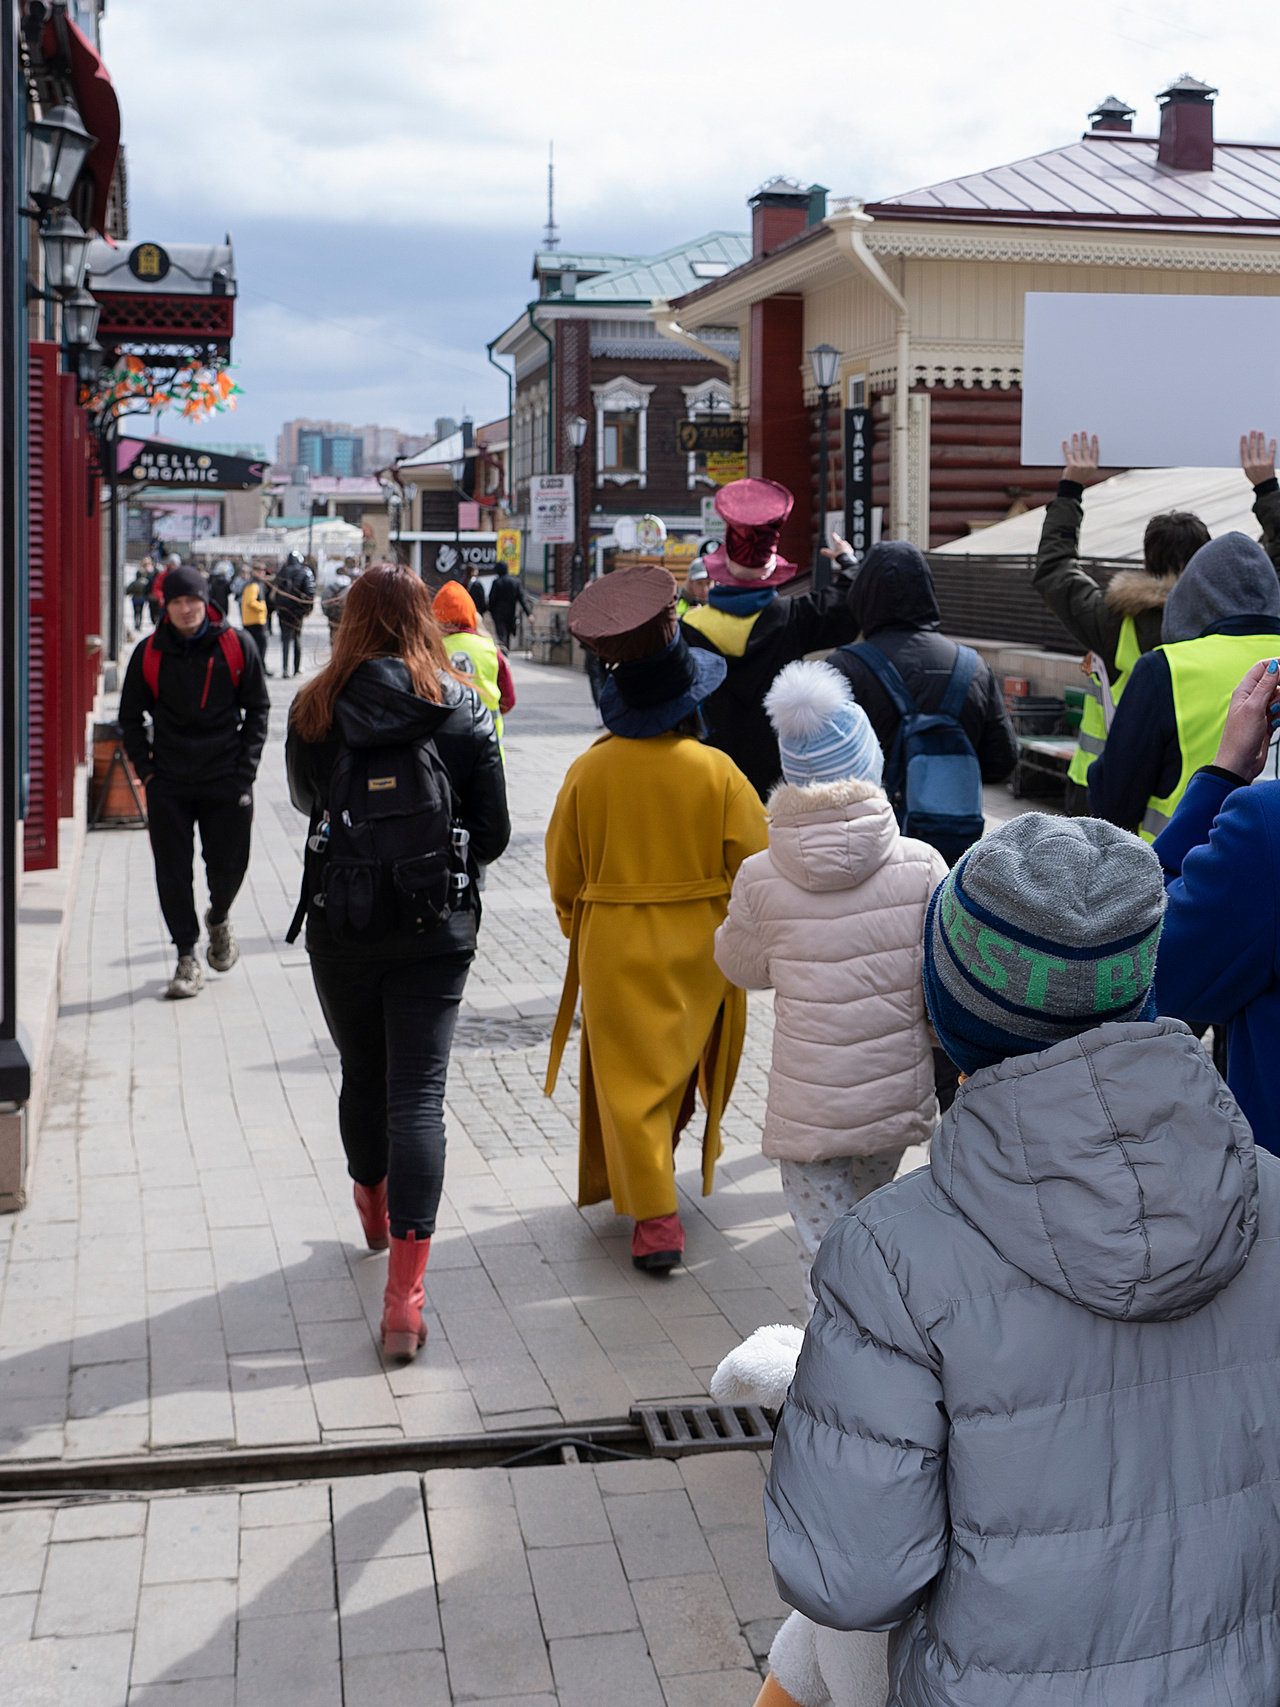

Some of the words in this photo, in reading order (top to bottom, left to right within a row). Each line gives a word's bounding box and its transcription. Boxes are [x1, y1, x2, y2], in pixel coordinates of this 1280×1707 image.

[141, 453, 211, 469] HELLO
[852, 414, 865, 482] VAPE
[133, 465, 219, 482] ORGANIC
[853, 499, 865, 561] SHOP
